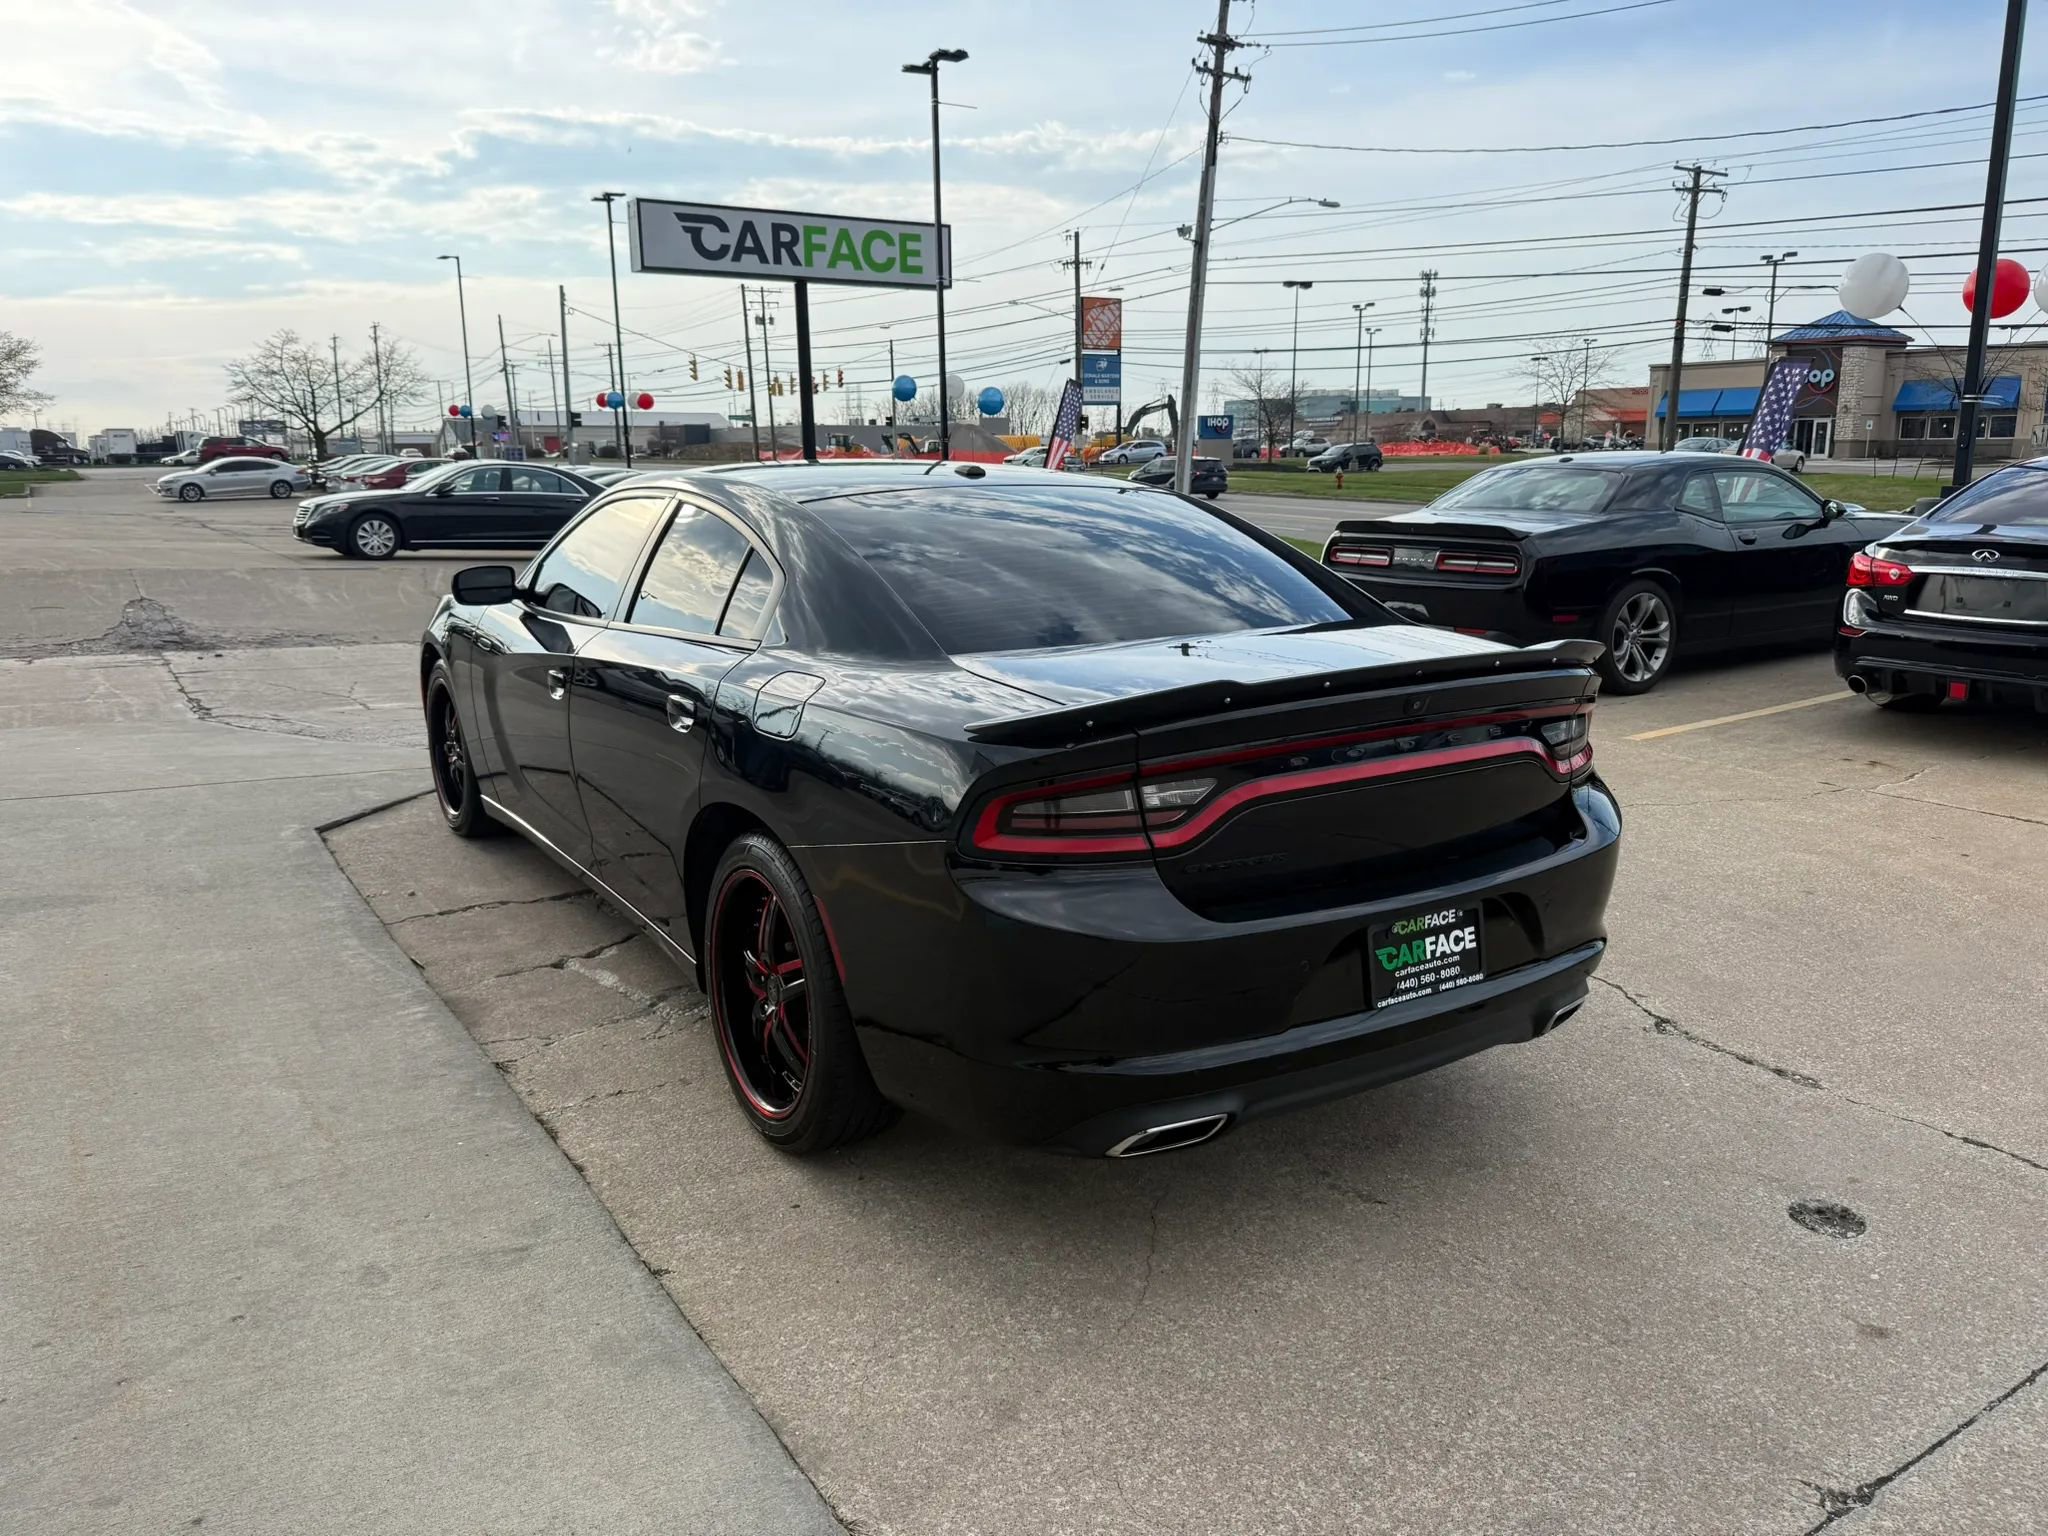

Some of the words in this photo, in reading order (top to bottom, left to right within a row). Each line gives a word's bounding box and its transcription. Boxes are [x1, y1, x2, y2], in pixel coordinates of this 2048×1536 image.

[673, 212, 923, 275] CARFACE
[1394, 909, 1456, 935] CARFACE
[1375, 926, 1477, 971] CARFACE
[1395, 955, 1460, 977] carfaceauto.com
[1397, 977, 1418, 990] (440)
